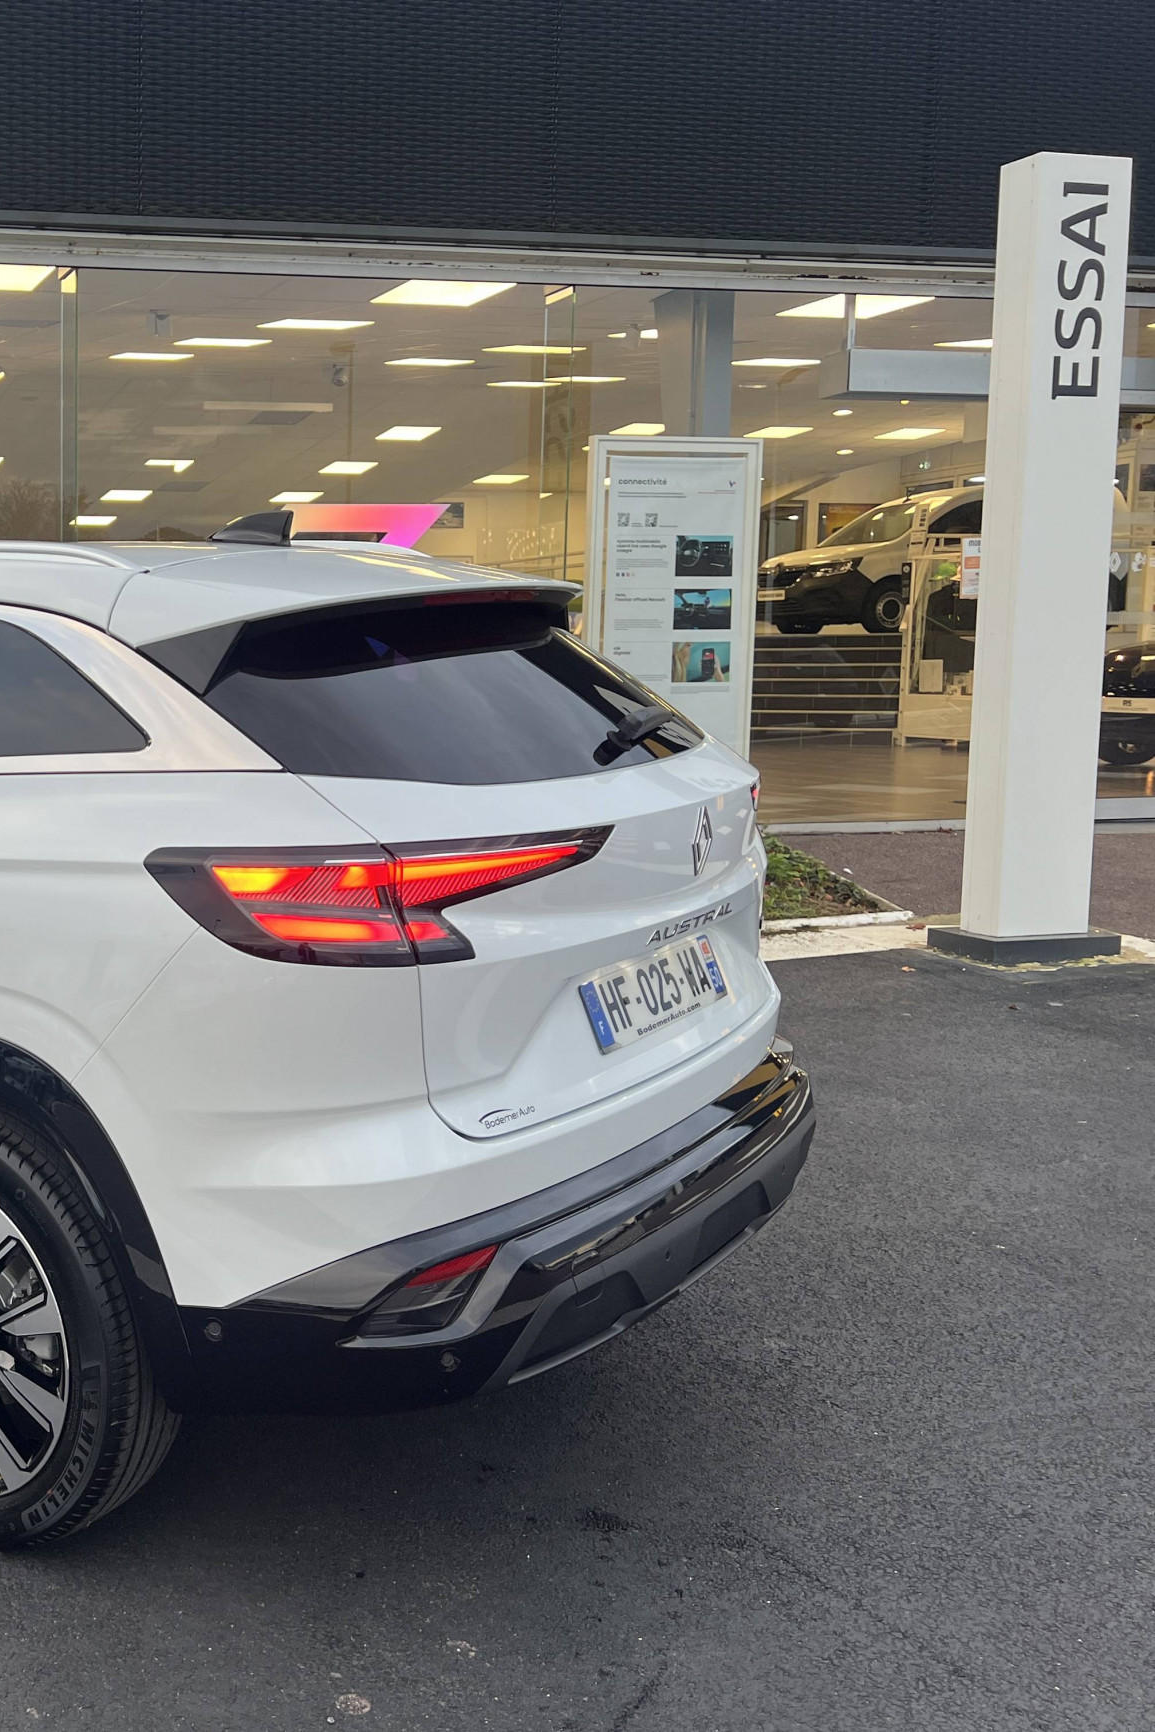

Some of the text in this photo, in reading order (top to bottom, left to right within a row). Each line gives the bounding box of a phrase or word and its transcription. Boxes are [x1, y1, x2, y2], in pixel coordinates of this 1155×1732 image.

[1052, 181, 1109, 400] ESSAI
[618, 478, 667, 486] connectivité
[646, 902, 732, 946] AUSTRAL
[708, 966, 723, 988] 50
[598, 1021, 605, 1035] F
[637, 1002, 701, 1036] BodemerAuto.com
[27, 1418, 96, 1528] MICHELIN
